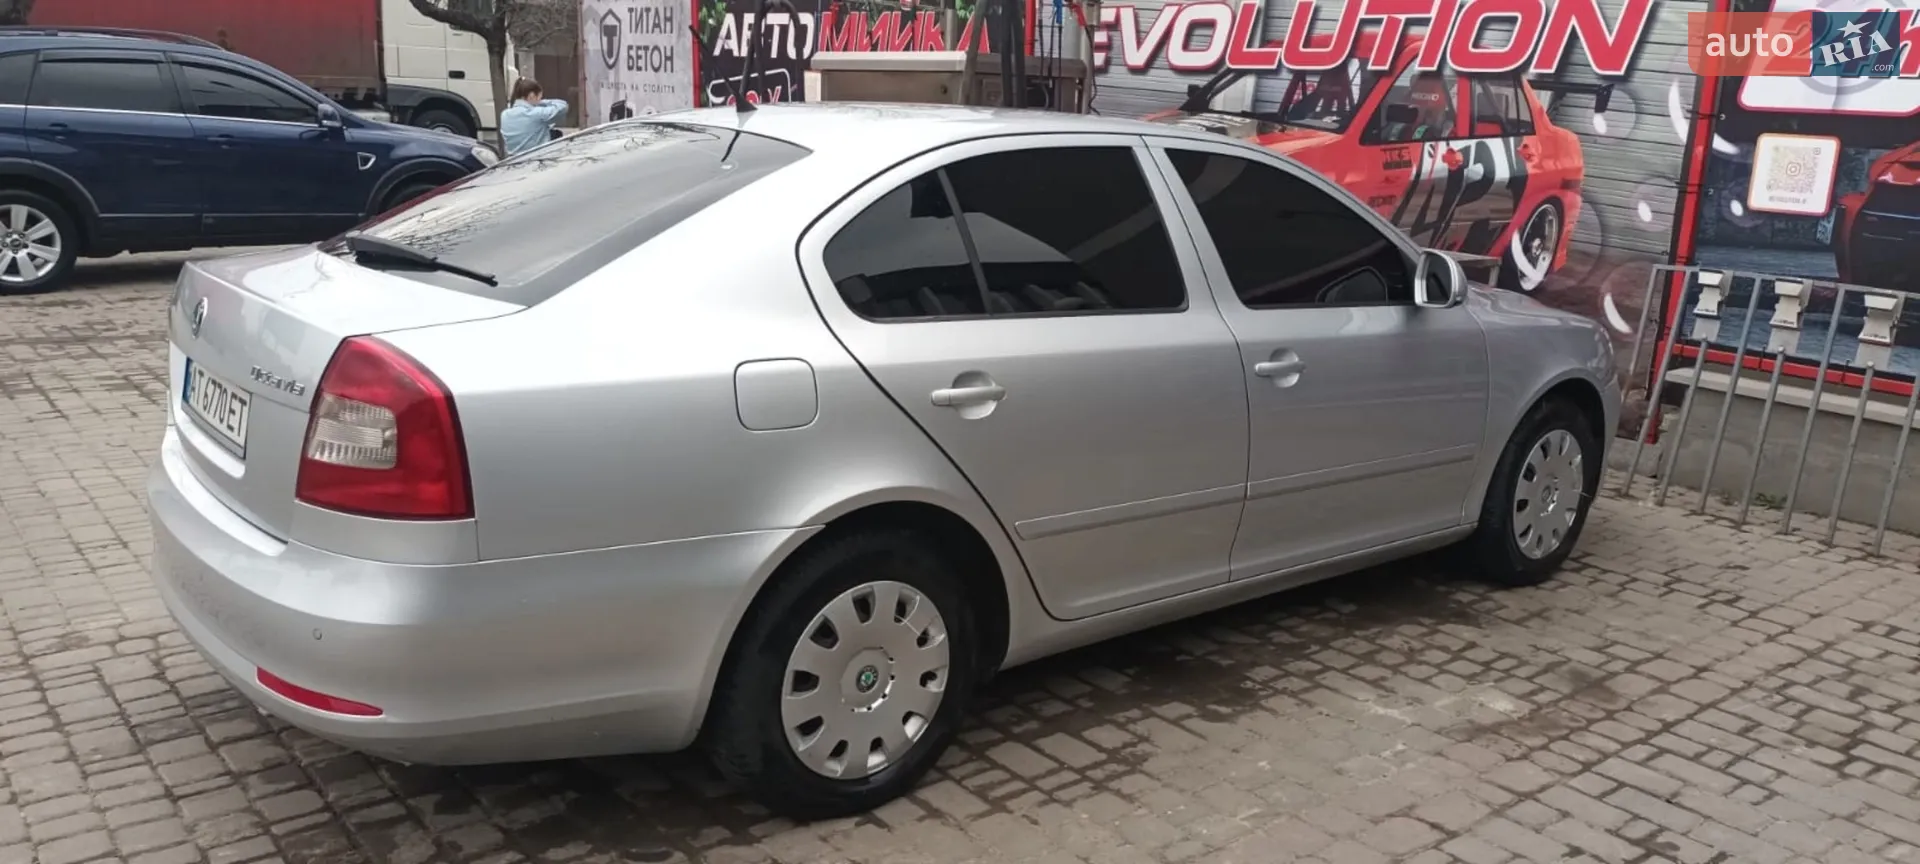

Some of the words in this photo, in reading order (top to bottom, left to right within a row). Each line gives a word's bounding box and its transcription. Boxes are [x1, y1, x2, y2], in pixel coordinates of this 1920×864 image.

[627, 6, 674, 34] ТИТАН
[1094, 0, 1651, 75] EVOLUTION
[627, 44, 674, 73] БЕТОН
[191, 366, 204, 406] AT
[202, 376, 228, 424] 6770
[226, 391, 248, 437] ET
